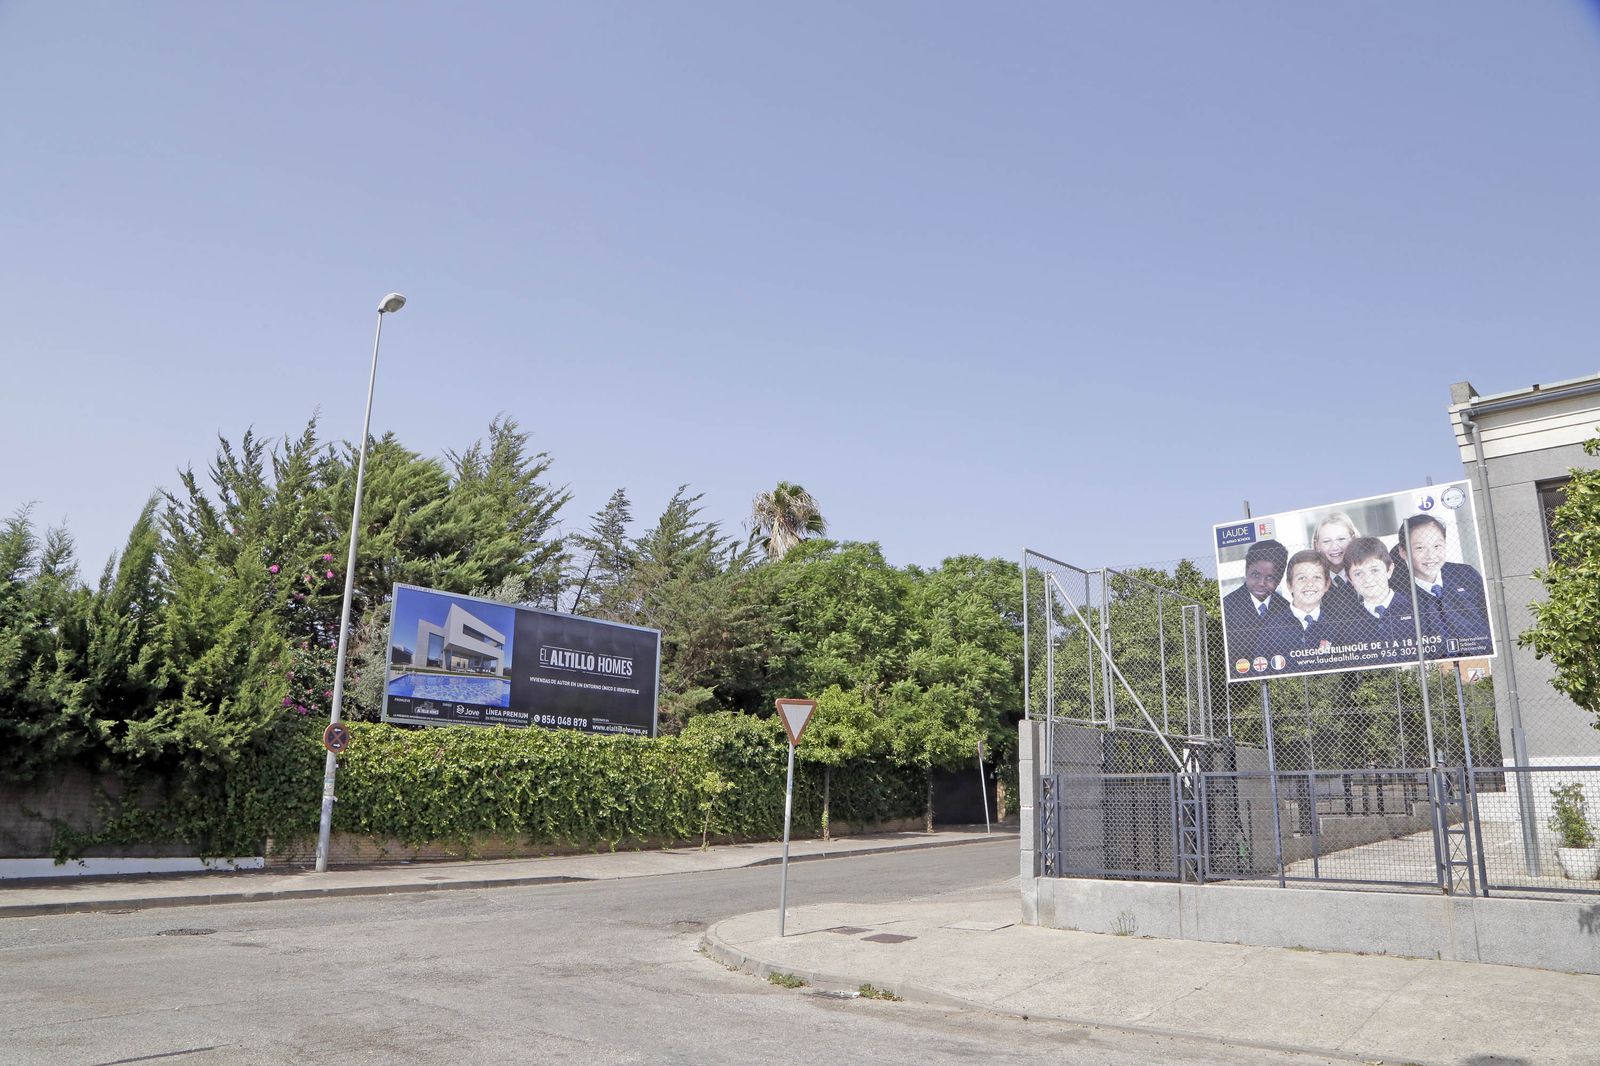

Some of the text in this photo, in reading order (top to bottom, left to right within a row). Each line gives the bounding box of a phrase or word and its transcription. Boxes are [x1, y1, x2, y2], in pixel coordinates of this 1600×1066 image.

[1222, 526, 1248, 538] LAUDE
[1290, 648, 1324, 658] COLEGIO
[1325, 642, 1368, 654] TRILINGÜE
[1371, 641, 1382, 650] DE
[1392, 640, 1400, 648] A
[1402, 638, 1413, 646] 18
[540, 648, 632, 676] EL ALTILLO HOMES
[1296, 652, 1378, 665] www.laudealtillo.com
[1400, 648, 1417, 656] 302
[485, 707, 528, 718] LÍNEA PREMIUM
[542, 714, 556, 724] 856
[558, 716, 572, 726] 048
[573, 717, 588, 728] 878
